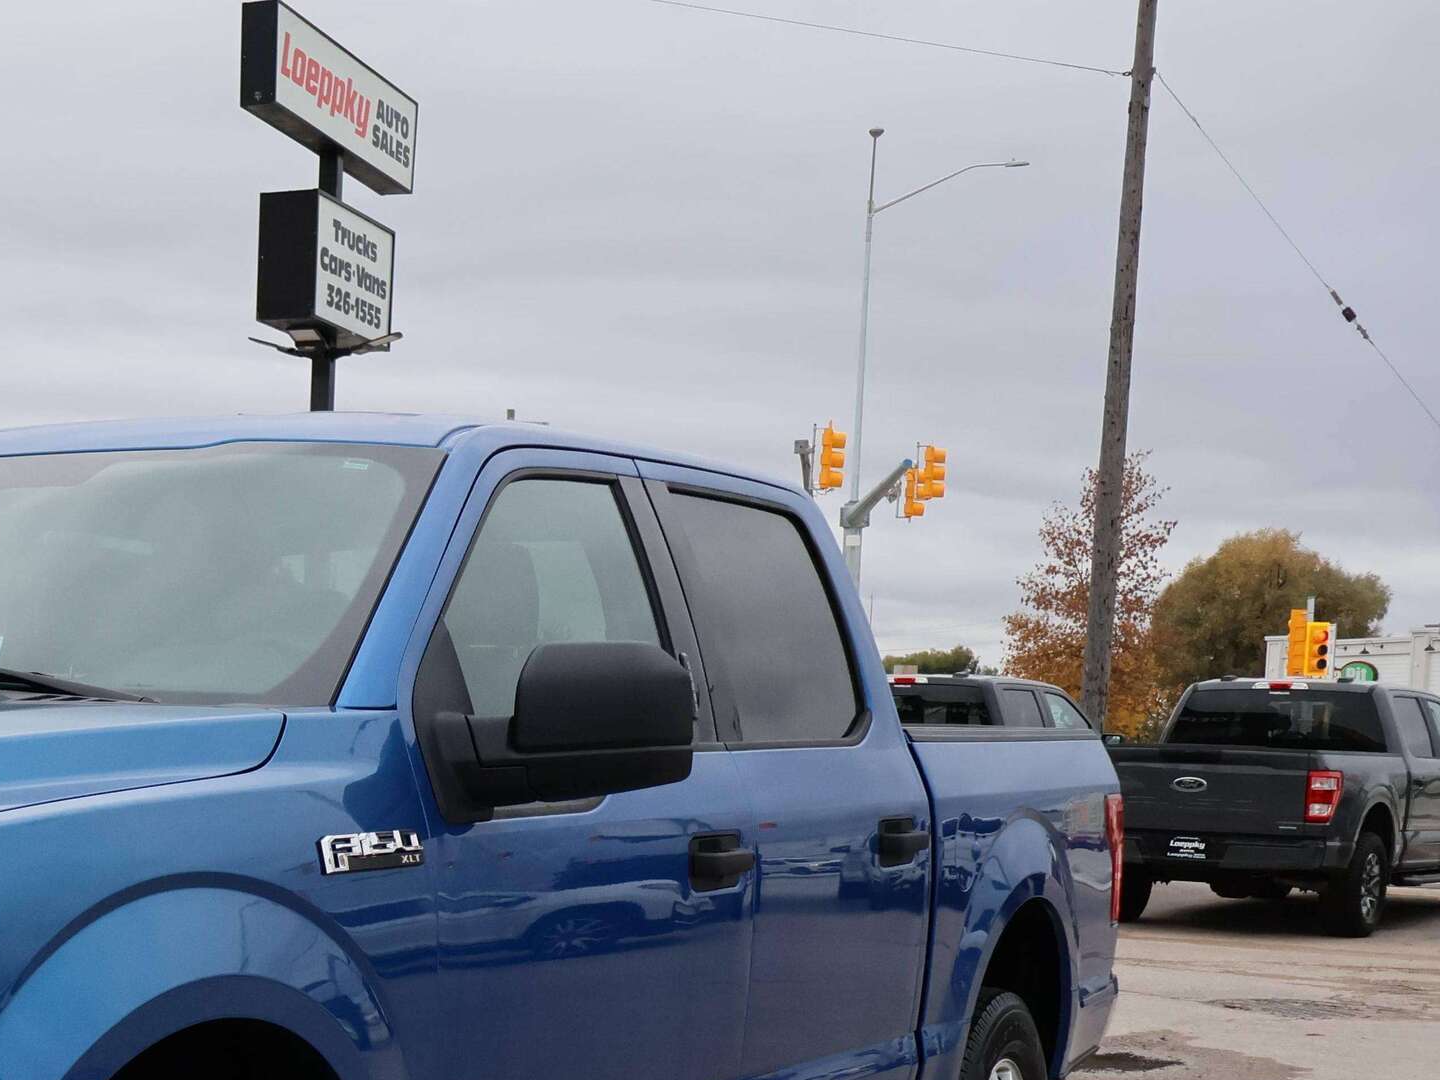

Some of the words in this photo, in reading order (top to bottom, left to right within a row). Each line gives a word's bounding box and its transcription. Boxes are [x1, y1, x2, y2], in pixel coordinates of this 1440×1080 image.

[280, 32, 371, 138] Loeppky
[375, 97, 410, 140] AUTO
[371, 123, 411, 169] SALES
[332, 218, 378, 263] Trucks
[401, 854, 421, 864] XLT
